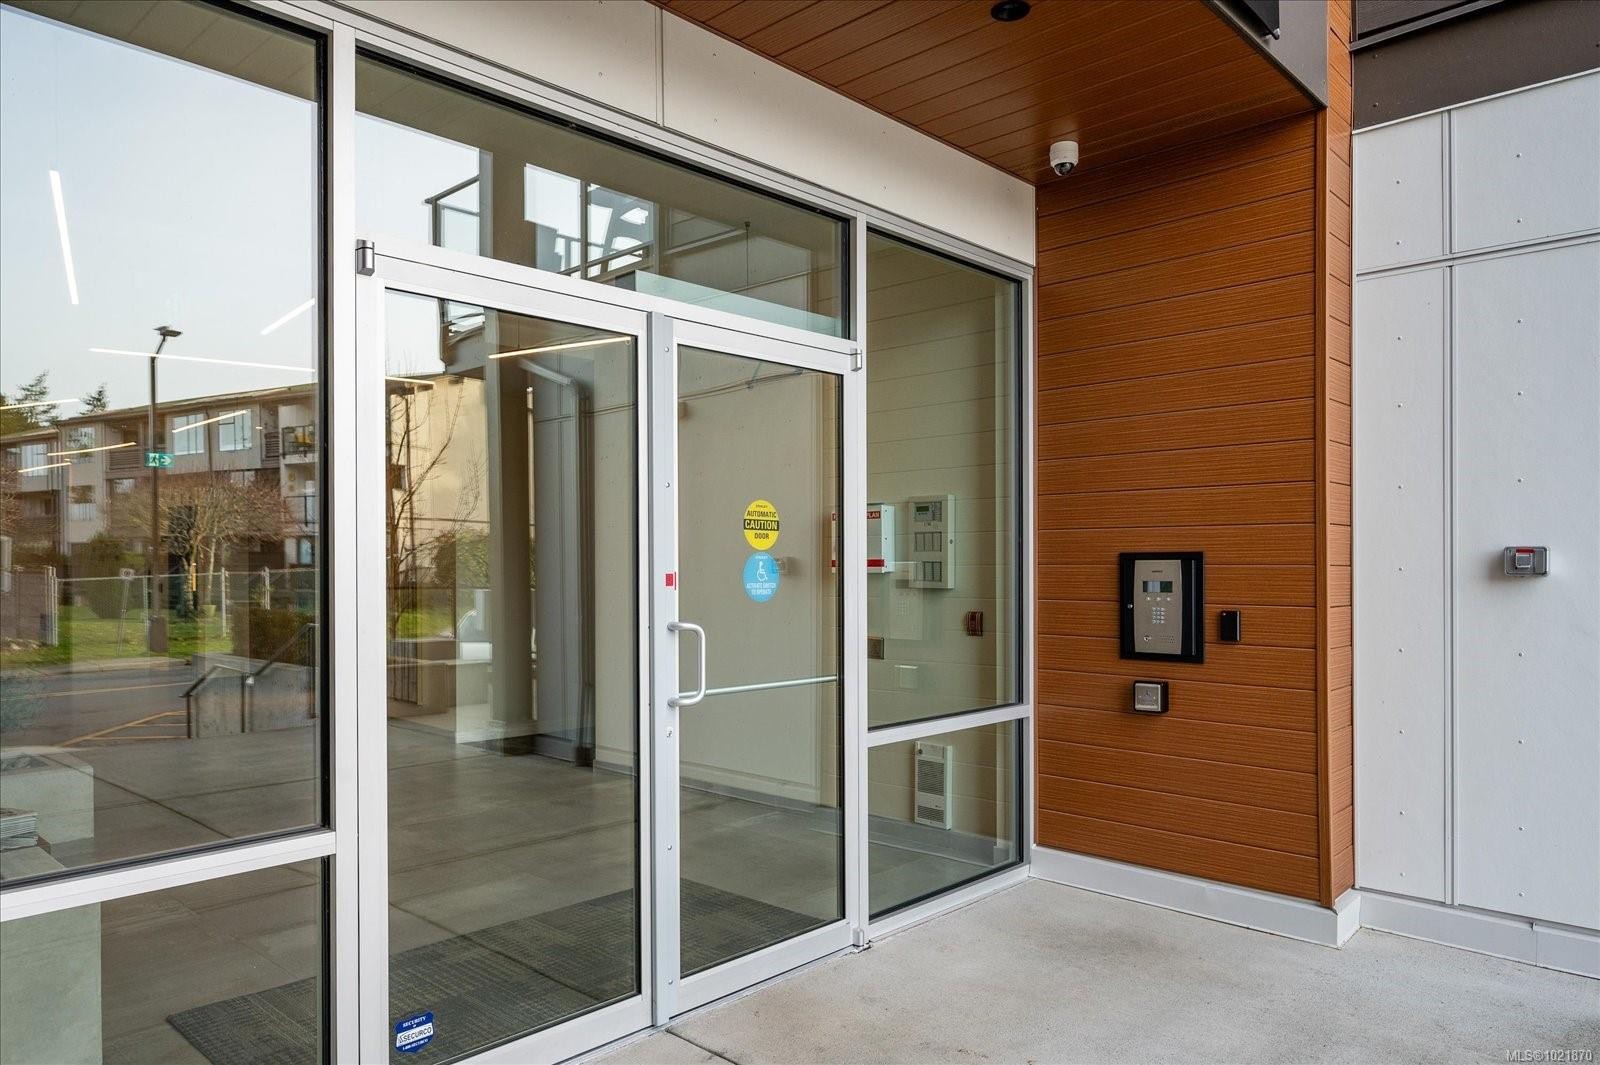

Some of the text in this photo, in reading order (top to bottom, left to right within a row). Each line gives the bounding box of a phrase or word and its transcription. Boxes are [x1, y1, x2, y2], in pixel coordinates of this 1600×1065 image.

[746, 510, 777, 518] AUTOMATIC
[744, 519, 778, 530] CAUTION
[402, 1015, 427, 1028] SECURITY
